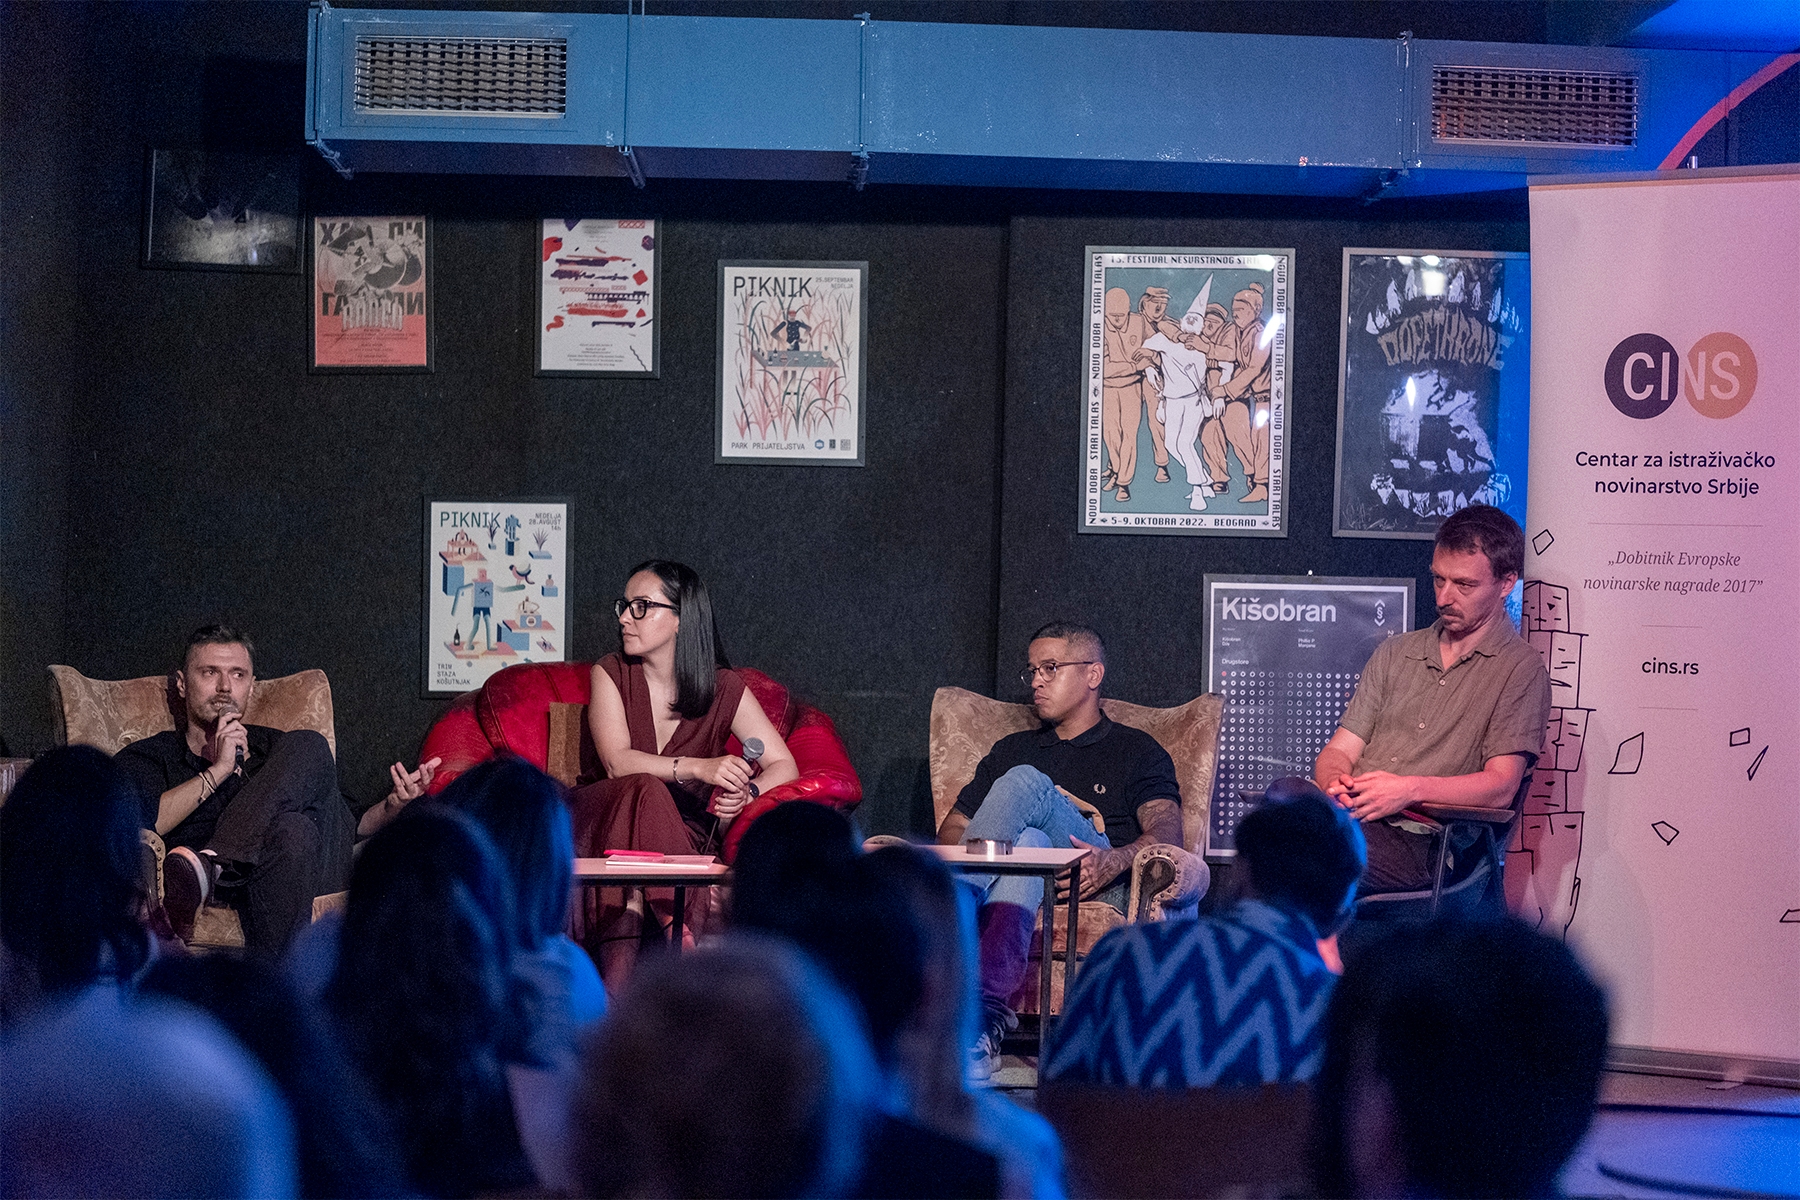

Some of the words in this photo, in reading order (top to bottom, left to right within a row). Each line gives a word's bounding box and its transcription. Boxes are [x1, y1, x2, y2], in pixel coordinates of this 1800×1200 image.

[1094, 255, 1103, 284] TALAS
[1127, 256, 1168, 264] FESTIVAL
[733, 276, 812, 298] PIKNIK
[1093, 287, 1102, 314] STARI
[1276, 289, 1286, 314] DOBA
[1093, 322, 1101, 349] DOBA
[1377, 305, 1515, 370] DOPETHRONE
[1275, 353, 1284, 382] TALAS
[1623, 351, 1741, 401] CINS
[1091, 401, 1100, 430] TALAS
[1090, 433, 1099, 460] STARI
[1273, 435, 1283, 461] DOBA
[1575, 451, 1638, 467] Centar
[1643, 455, 1663, 467] za
[1669, 451, 1776, 468] istraživačko
[1089, 468, 1098, 494] DOBA
[1272, 469, 1282, 496] STARI
[1595, 477, 1702, 494] novinarstvo
[1707, 478, 1759, 498] Srbije
[440, 511, 501, 528] PIKNIK
[1111, 517, 1132, 525] 5-9.
[1134, 518, 1177, 526] OKTOBRA
[1179, 518, 1207, 526] 2022.
[1214, 518, 1257, 527] BEOGRAD
[1272, 498, 1281, 528] TALAS
[1608, 551, 1674, 566] „Dobitnik
[1677, 552, 1741, 569] Evropske
[1583, 576, 1660, 592] novinarske
[1664, 578, 1720, 595] nagrade
[1723, 579, 1764, 593] 2017”
[1222, 597, 1337, 622] Kišobran
[1222, 658, 1250, 666] Drugstore
[1641, 657, 1699, 675] cins.rs
[436, 677, 471, 685] KOŠUTNJAK
